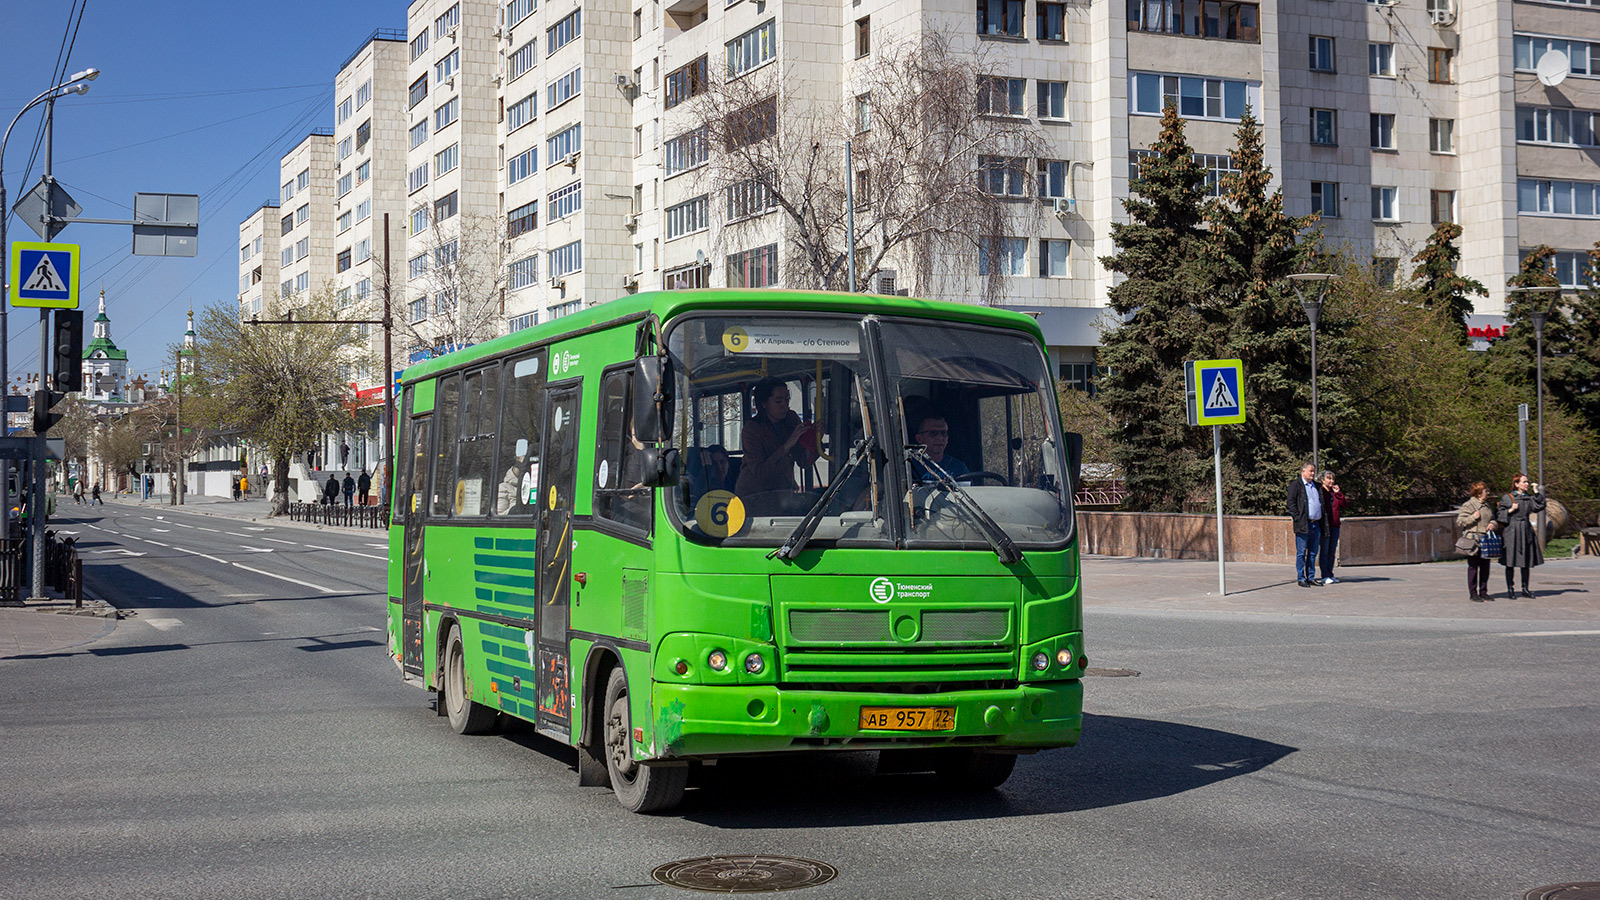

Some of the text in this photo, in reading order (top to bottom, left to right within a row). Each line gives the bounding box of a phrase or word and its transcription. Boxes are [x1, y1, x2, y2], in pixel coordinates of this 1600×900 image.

[731, 332, 741, 346] 6
[768, 338, 794, 346] Апрель
[803, 338, 815, 347] с/о
[816, 338, 850, 347] Степное
[711, 502, 729, 526] 6
[896, 582, 933, 590] Тюменский
[897, 591, 930, 599] транспорт
[896, 710, 926, 727] 957
[936, 709, 949, 722] 72
